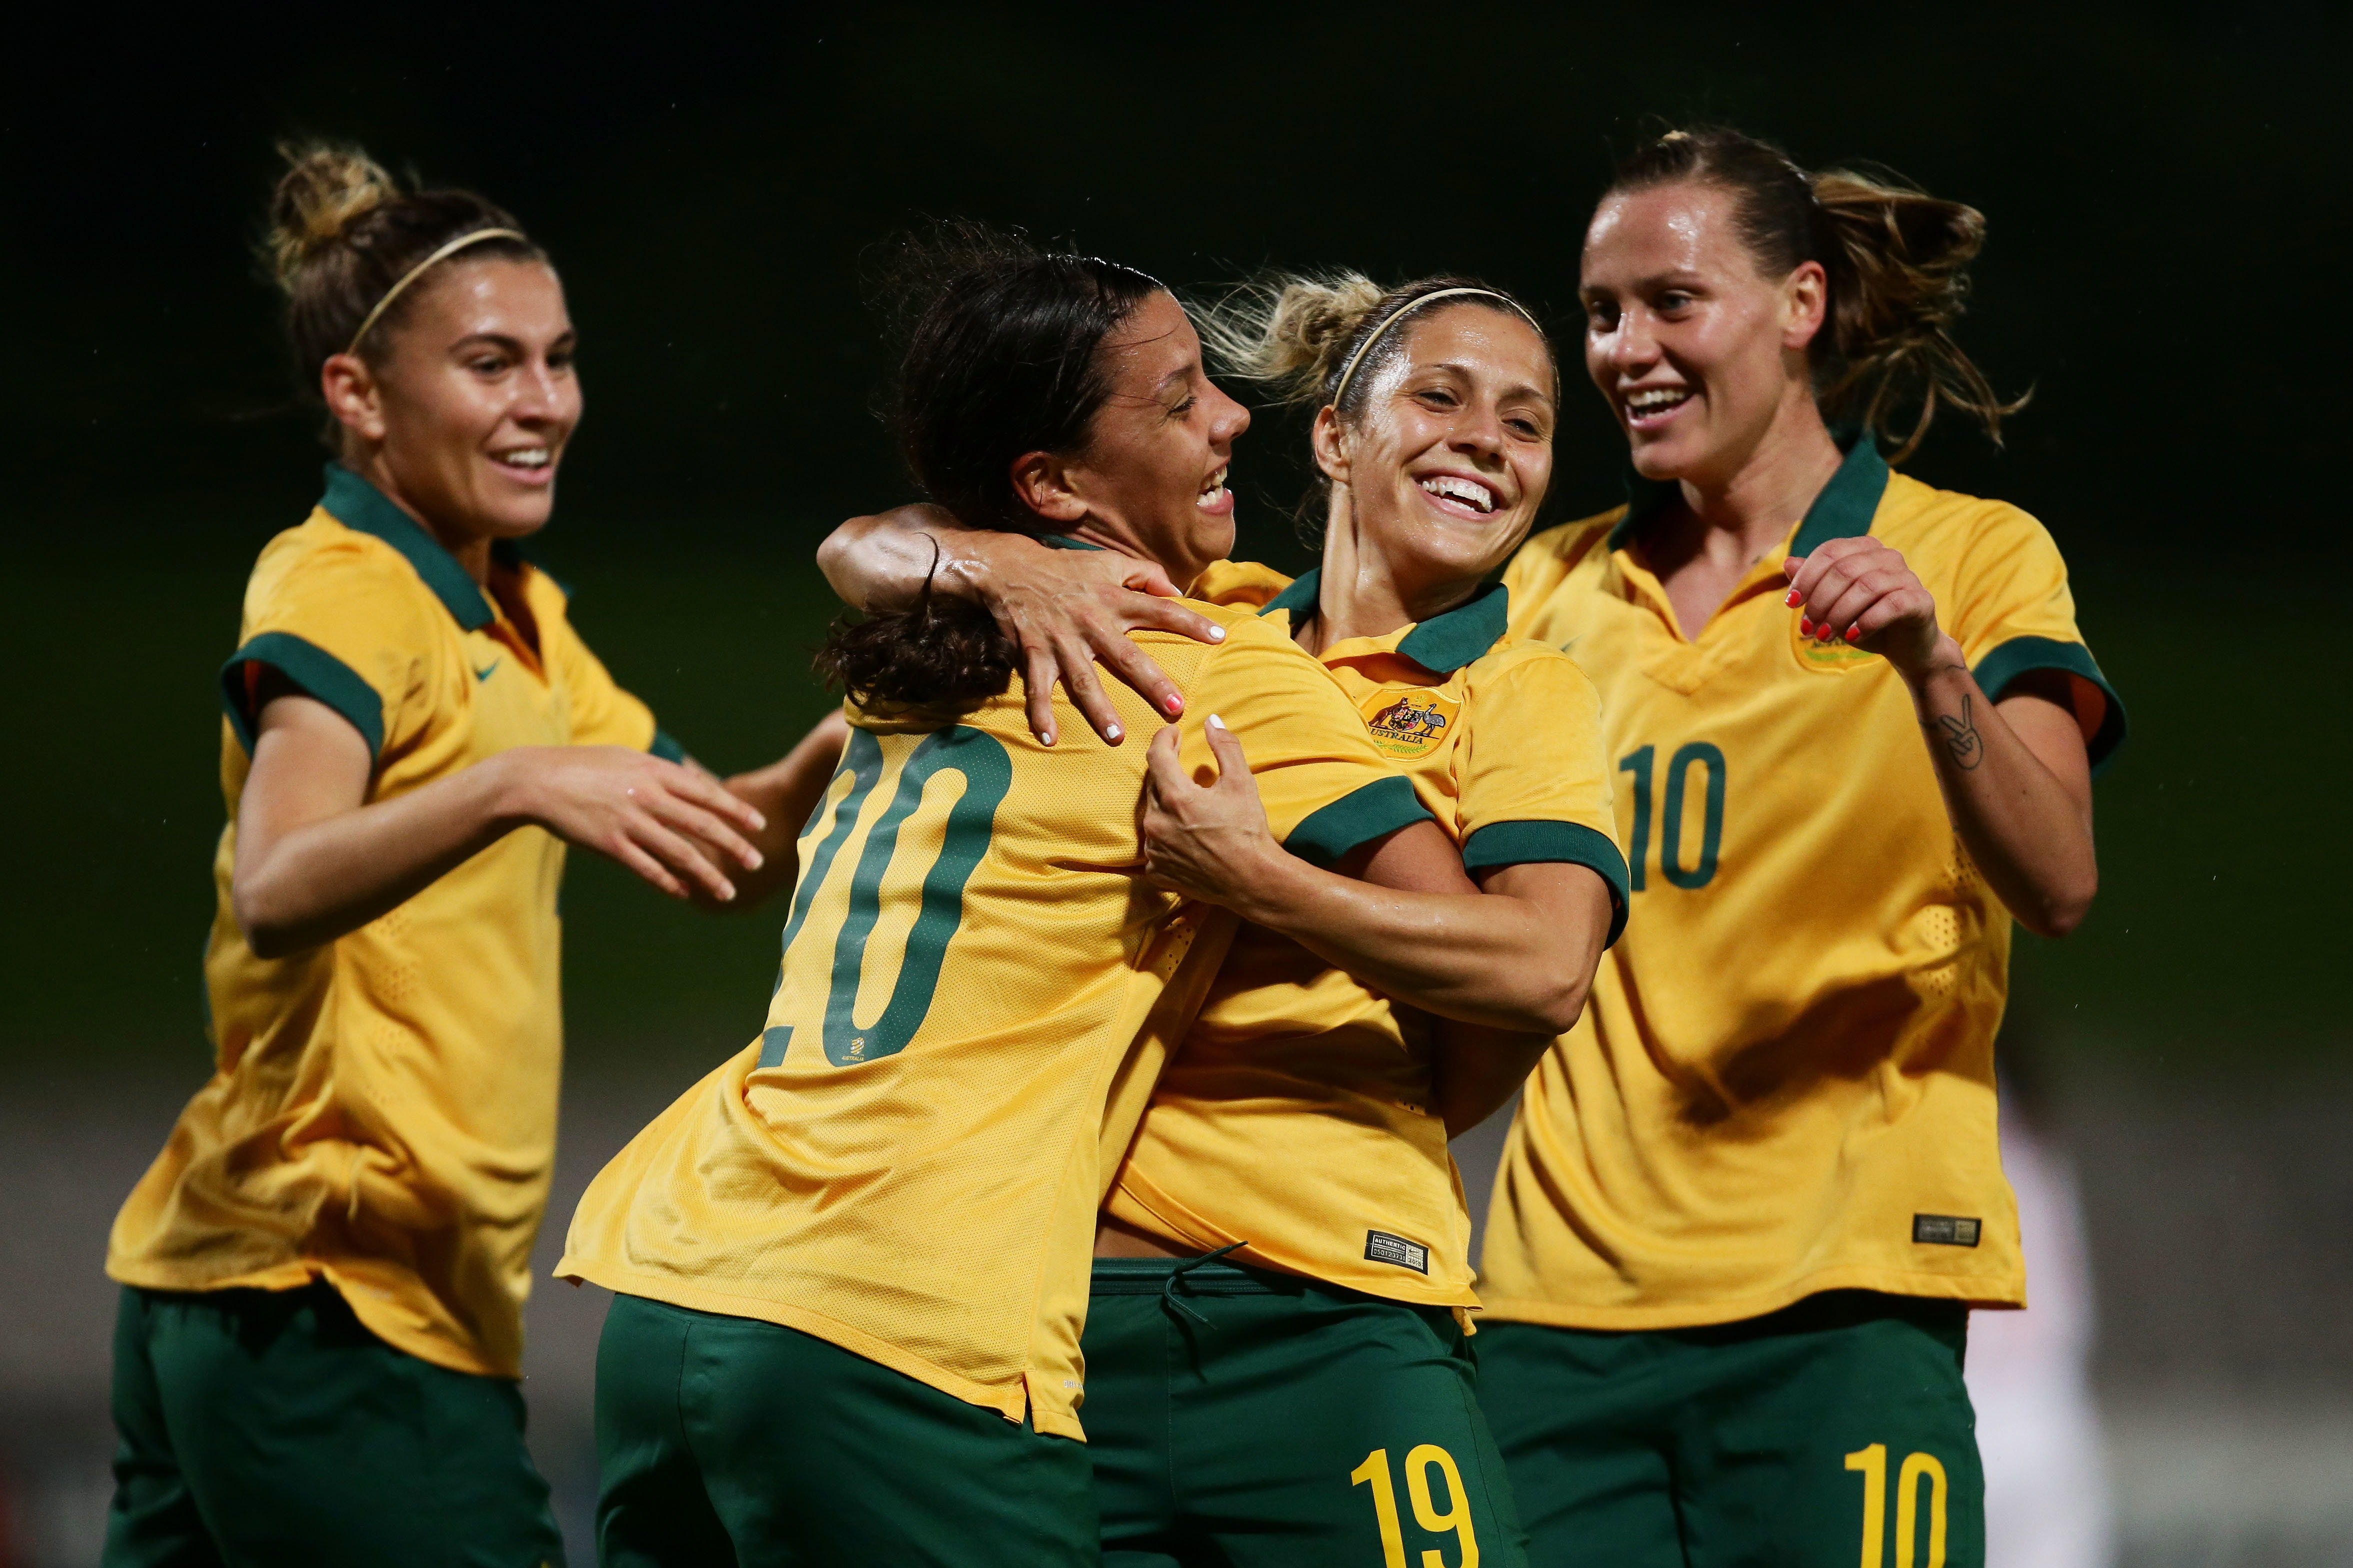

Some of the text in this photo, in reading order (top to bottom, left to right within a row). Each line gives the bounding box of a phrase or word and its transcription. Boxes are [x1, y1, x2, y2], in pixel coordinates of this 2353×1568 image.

[1370, 728, 1422, 744] USTRALIA
[1618, 741, 1726, 891] 10
[756, 725, 1012, 1067] 20
[1375, 1238, 1406, 1250] AUTHENTIC
[1351, 1444, 1479, 1568] 19
[1844, 1443, 1948, 1568] 10
